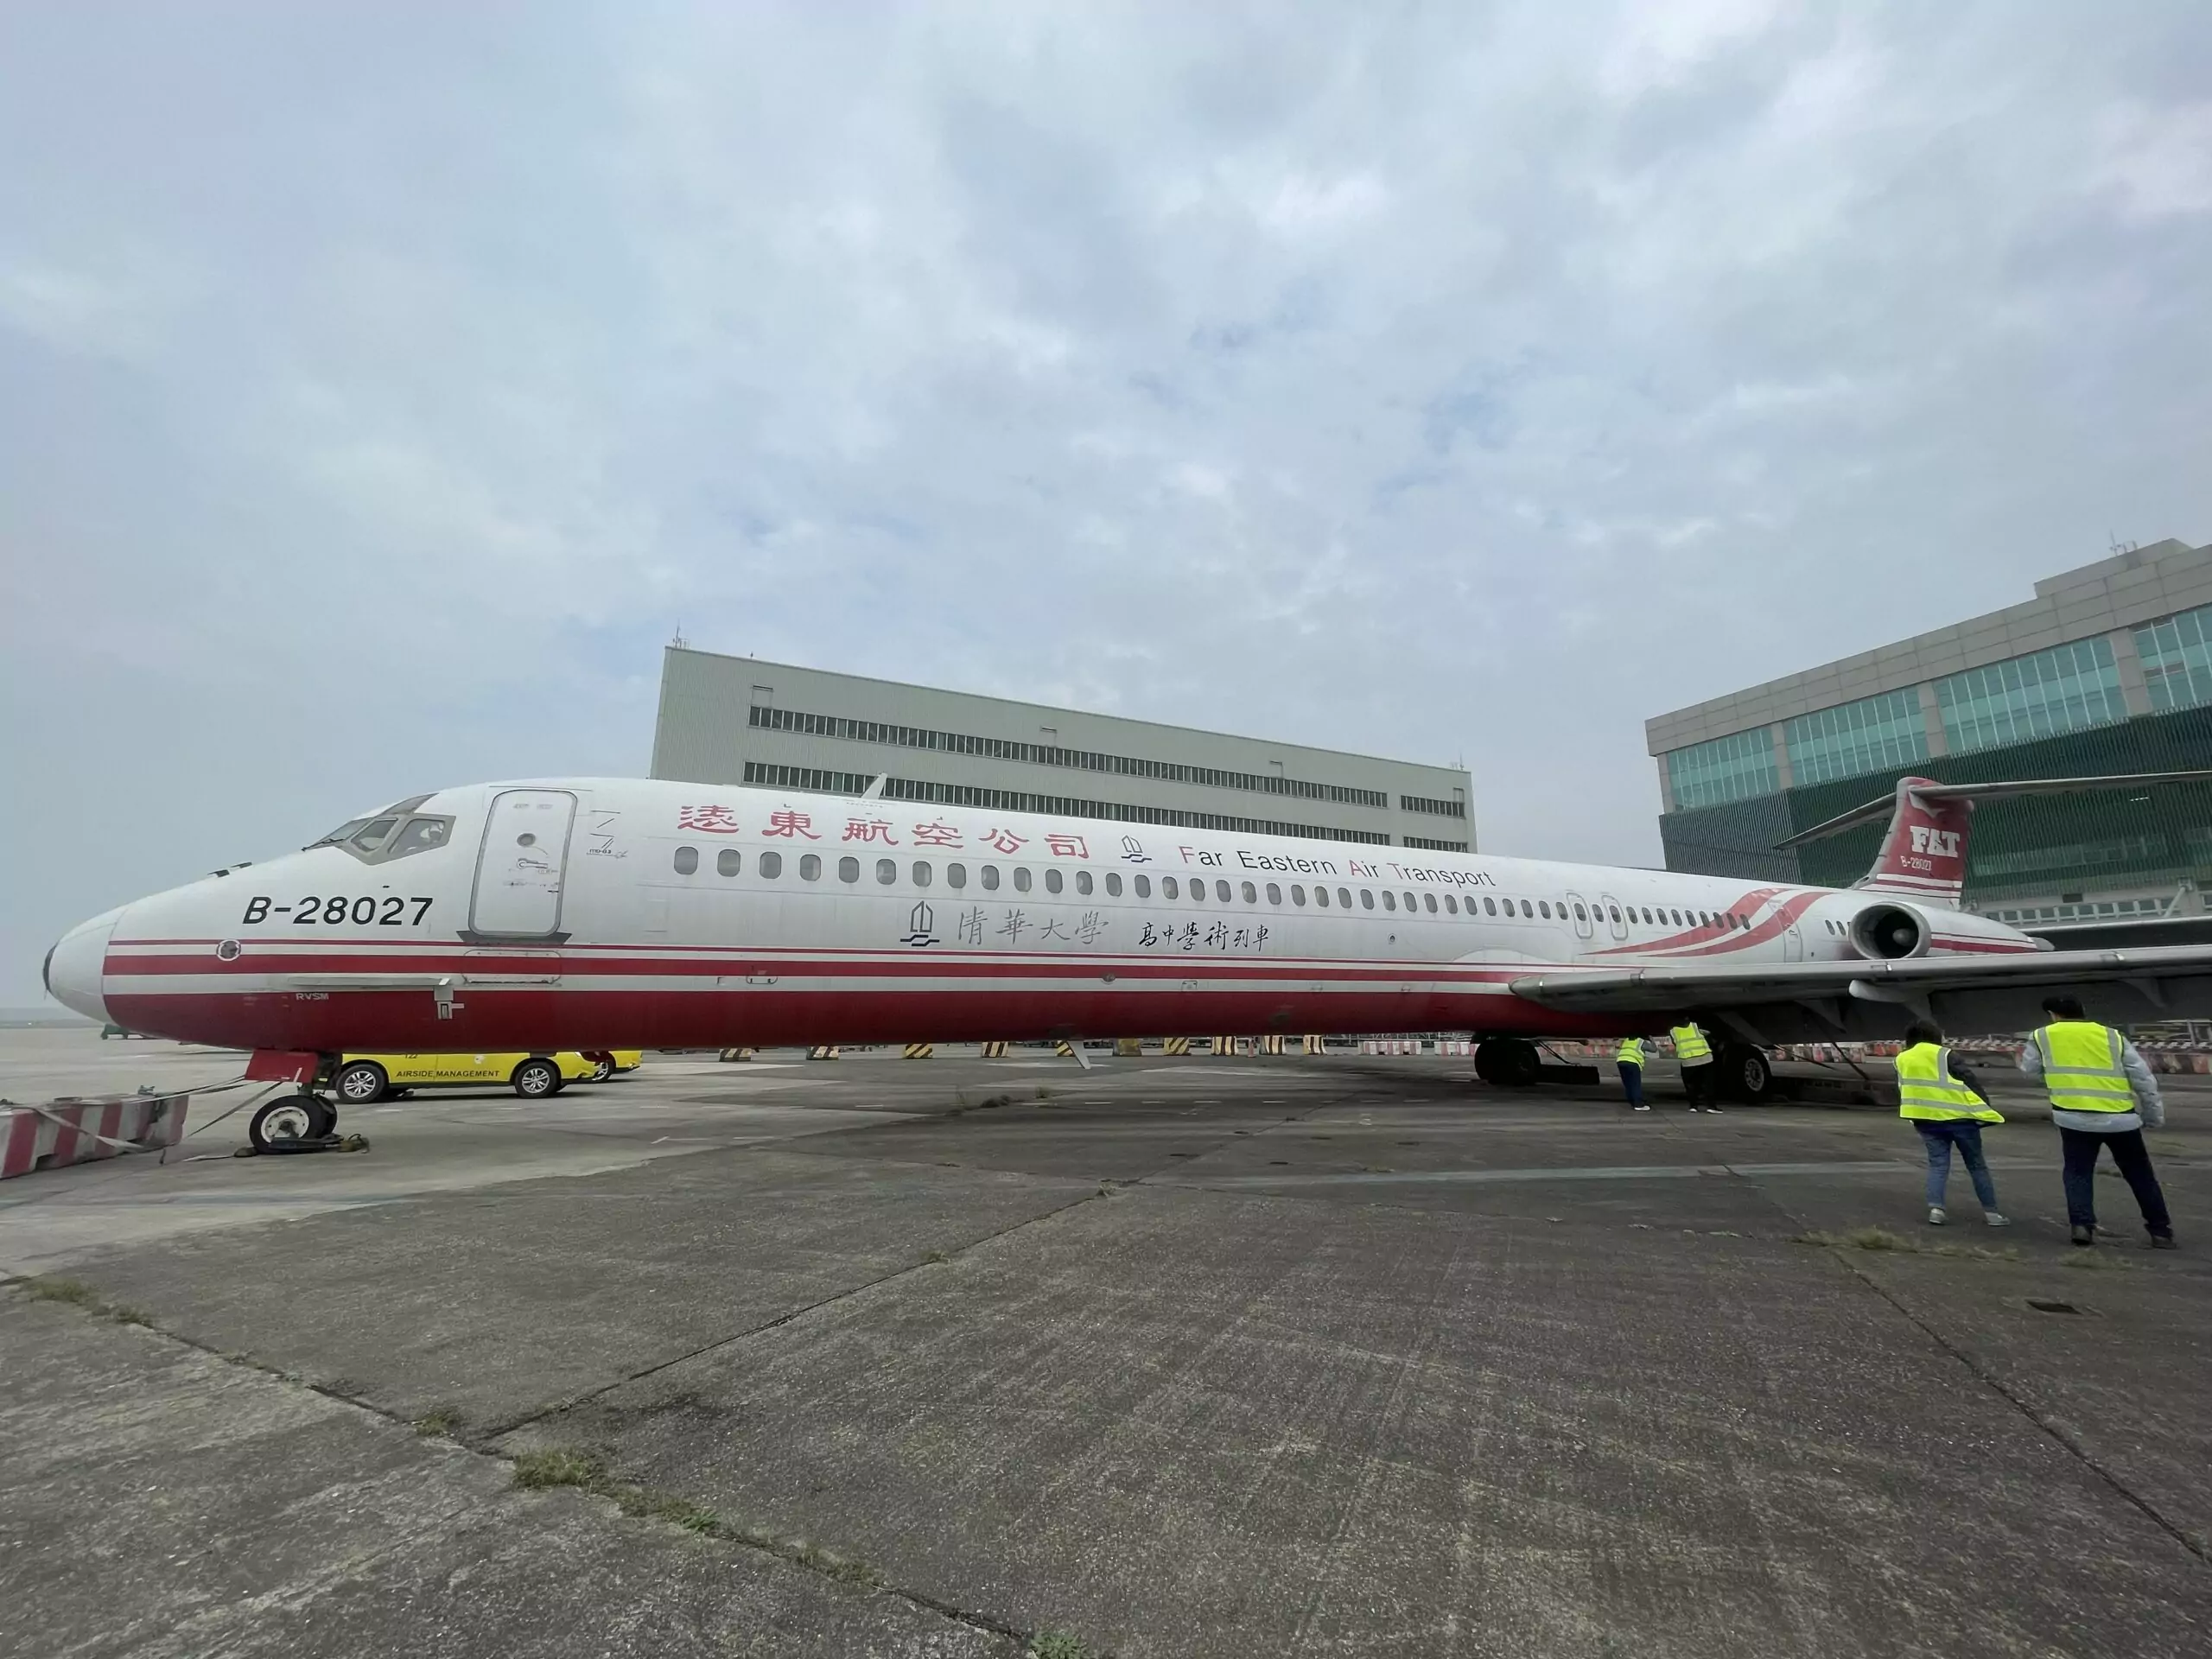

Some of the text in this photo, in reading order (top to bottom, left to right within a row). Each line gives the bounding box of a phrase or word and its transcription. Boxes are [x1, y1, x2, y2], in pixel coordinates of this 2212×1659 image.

[677, 804, 1088, 859] 遠東航空公司
[1910, 825, 1960, 857] FAT
[1179, 846, 1497, 888] Far Eastern Air Transport
[242, 896, 433, 925] B-28027
[958, 906, 1109, 944] 清華大學
[1139, 920, 1268, 951] 高中學術列車
[296, 992, 329, 1001] RVSM
